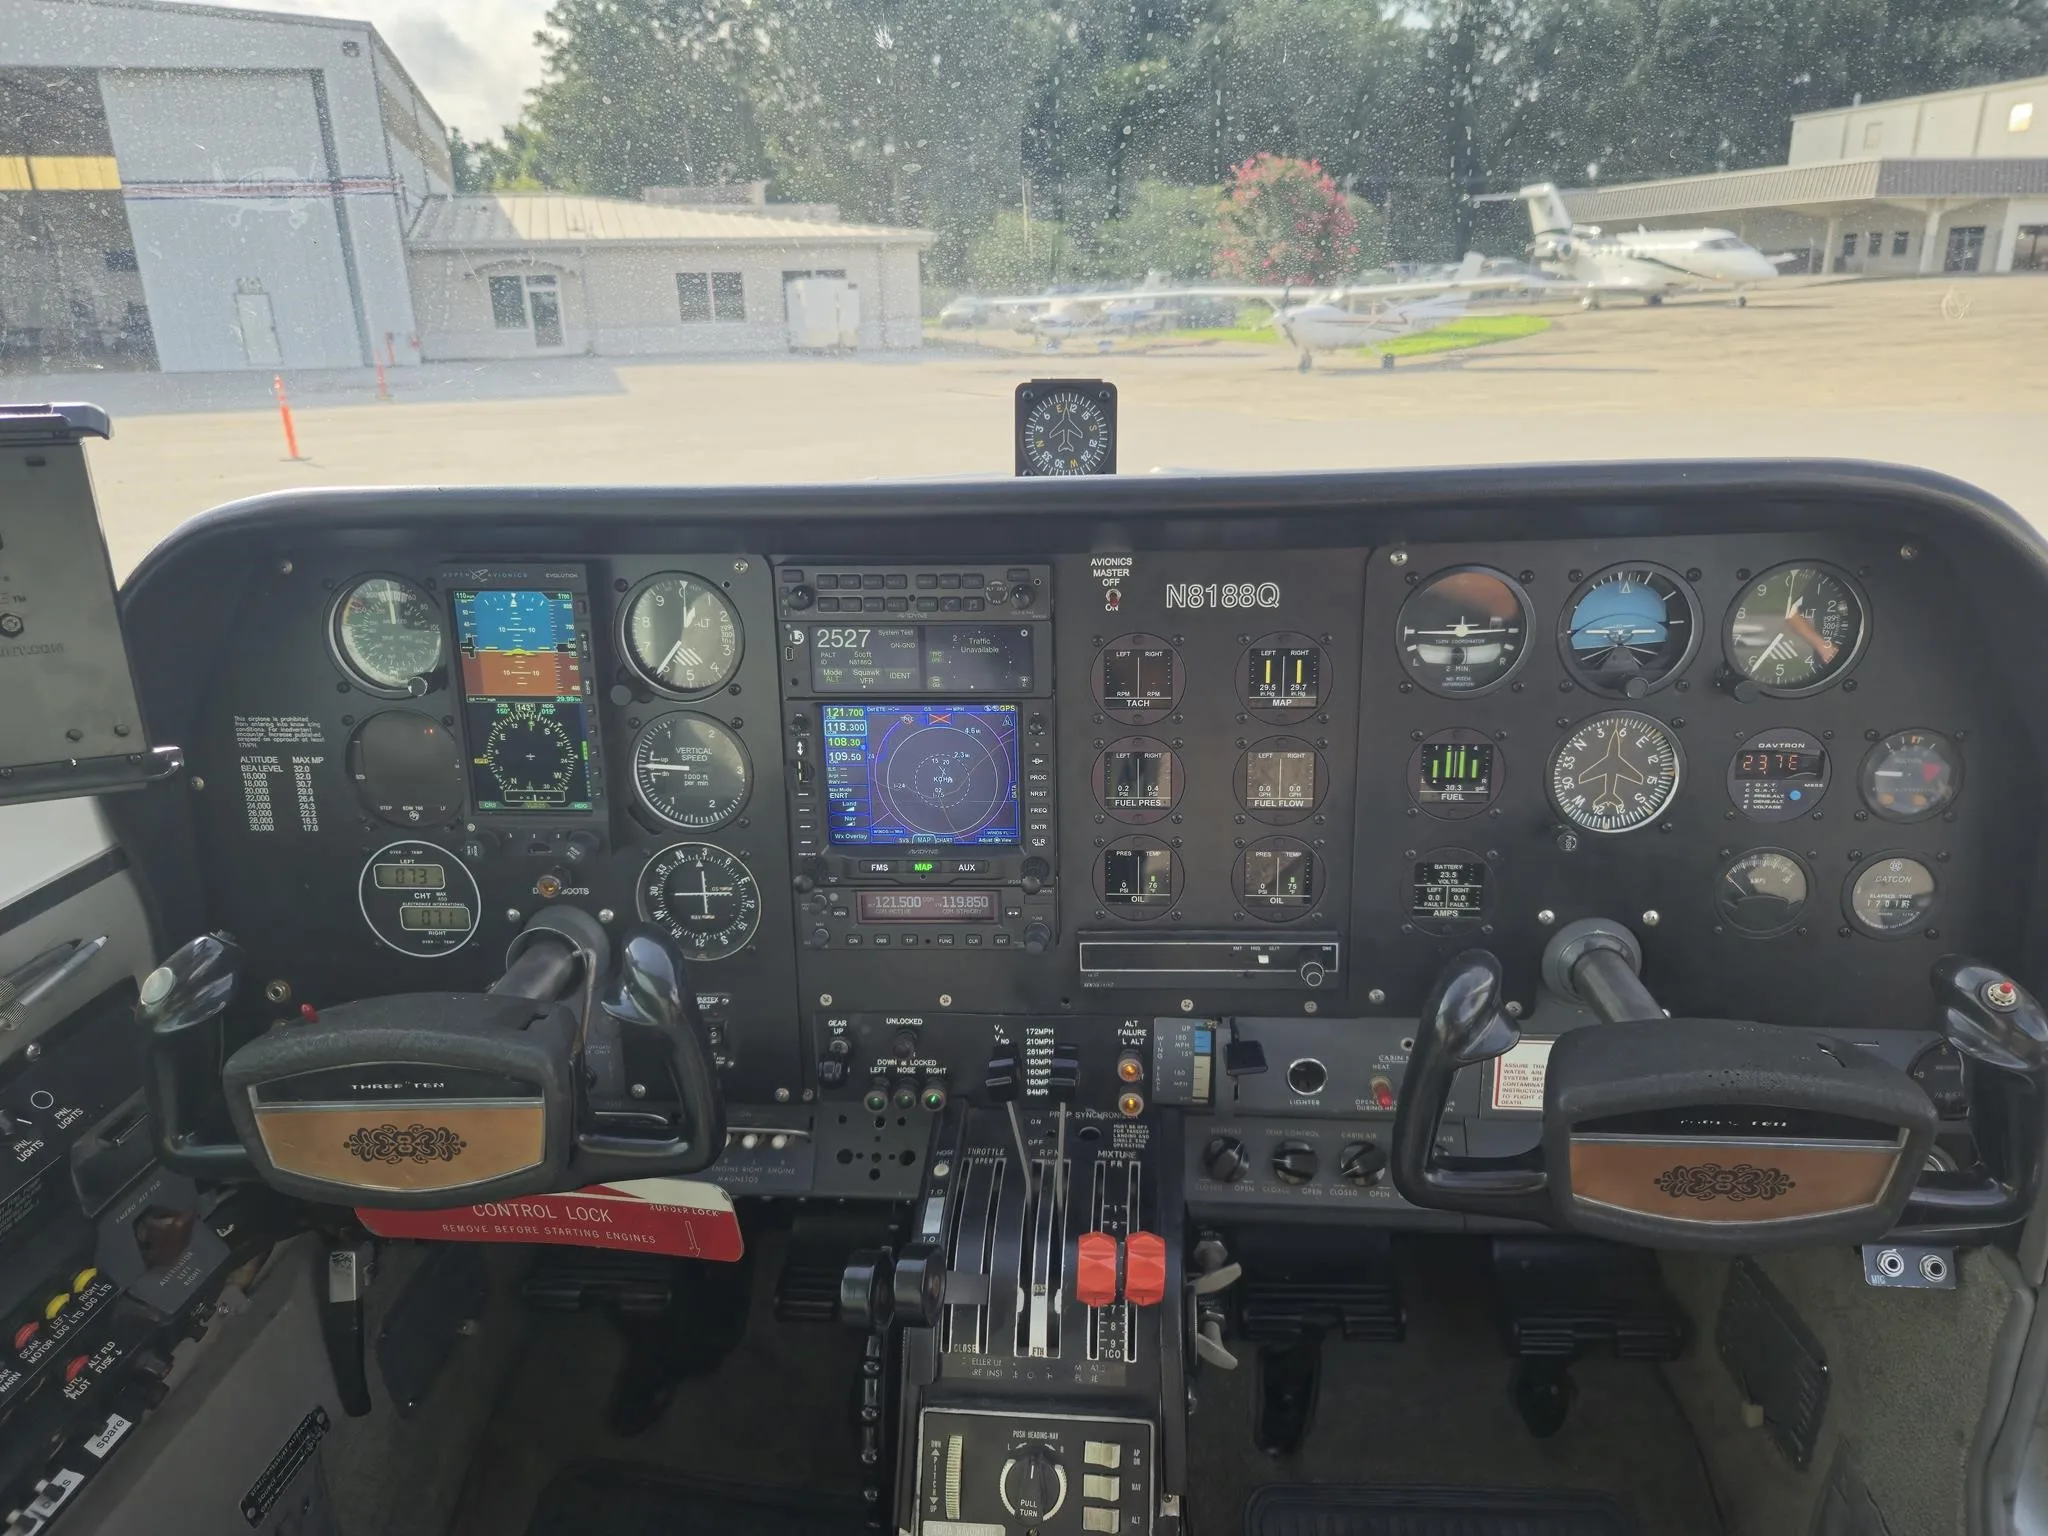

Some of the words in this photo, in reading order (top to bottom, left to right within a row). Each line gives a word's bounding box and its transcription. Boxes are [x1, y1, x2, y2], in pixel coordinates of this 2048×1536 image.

[1091, 558, 1132, 566] AVIONICS
[1093, 569, 1130, 577] MASTER
[1102, 578, 1120, 587] OFF
[1166, 583, 1280, 608] N8188Q
[1105, 604, 1119, 612] ON
[816, 629, 871, 648] 2527
[969, 637, 991, 645] Traffic
[960, 646, 999, 654] Unavailable
[852, 669, 880, 677] Squawk
[1126, 699, 1150, 707] TACH
[1272, 699, 1292, 707] MAP
[826, 707, 864, 717] 121.700
[827, 722, 865, 731] 118.300
[828, 737, 861, 746] 108.30
[1574, 739, 1588, 751] N
[1636, 735, 1649, 748] E
[675, 747, 713, 755] VERTICAL
[240, 756, 279, 764] ALTITUDE
[292, 756, 310, 764] MAX
[828, 752, 862, 761] 109.50
[293, 765, 310, 773] 32.0
[296, 780, 312, 788] 30.7
[1030, 790, 1047, 798] NRST
[1441, 793, 1464, 801] FUEL
[246, 802, 271, 810] 24,000
[1115, 799, 1137, 807] FUEL
[1138, 799, 1162, 807] PRES
[250, 824, 275, 832] 30,000
[1031, 823, 1047, 831] ENTR
[871, 863, 889, 872] FMS
[914, 862, 933, 872] MAP
[958, 863, 976, 872] AUX
[395, 868, 427, 884] 073
[875, 896, 922, 908] 121.500
[942, 896, 989, 908] 119.850
[1131, 895, 1145, 903] OIL
[1433, 909, 1459, 917] AMPS
[828, 1019, 848, 1027] GEAR
[54, 1106, 73, 1121] PNL
[57, 1108, 84, 1130] LIGHTS
[13, 1138, 33, 1153] PNL
[17, 1140, 45, 1163] LIGHTS
[975, 1157, 994, 1165] OPEN
[1369, 1190, 1391, 1198] OPEN
[473, 1203, 558, 1219] CONTROL
[565, 1205, 613, 1223] LOCK
[442, 1224, 489, 1234] REMOVE
[494, 1225, 538, 1235] BEFORE
[544, 1226, 600, 1238] STARTING
[606, 1231, 657, 1244] ENGINES
[78, 1283, 100, 1302] RIGHT
[27, 1339, 55, 1364] MOTOR
[53, 1324, 70, 1339] LDG
[69, 1310, 85, 1324] LTS
[82, 1297, 98, 1311] LDG
[97, 1283, 112, 1297] LTS
[953, 1343, 977, 1353] CLOSE
[88, 1354, 102, 1369] ALT
[101, 1341, 116, 1355] FLD
[95, 1355, 116, 1374] FUSE
[69, 1379, 91, 1400] PILOT
[96, 1418, 125, 1450] spare
[1012, 1430, 1026, 1438] PUSH
[1020, 1499, 1038, 1508] PULL
[1020, 1509, 1038, 1518] TURN
